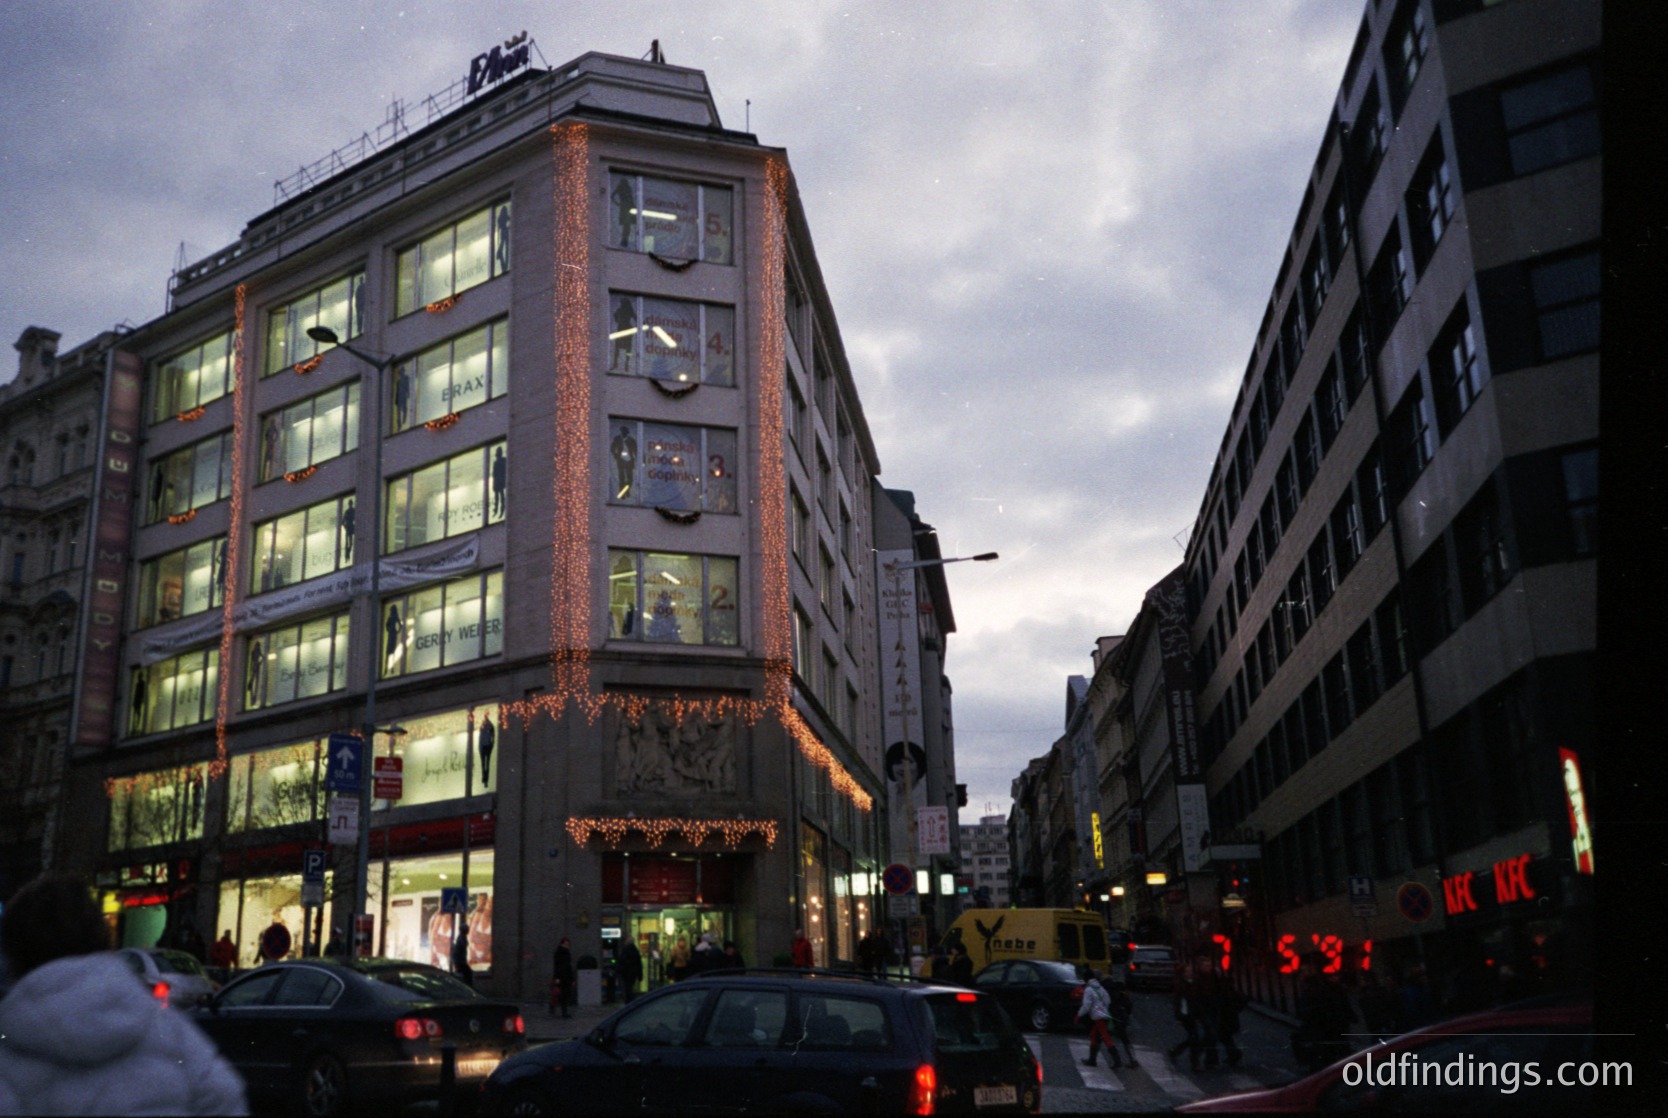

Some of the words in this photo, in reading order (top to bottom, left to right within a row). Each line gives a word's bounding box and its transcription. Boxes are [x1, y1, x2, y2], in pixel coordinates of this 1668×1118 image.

[706, 213, 728, 236] 5.
[707, 331, 731, 356] 4.
[709, 454, 733, 478] 3.
[711, 584, 735, 611] 2.
[308, 855, 321, 873] P
[1351, 878, 1370, 895] H
[1494, 854, 1535, 904] KFC
[1443, 871, 1478, 915] KFC
[993, 937, 1036, 950] nebe
